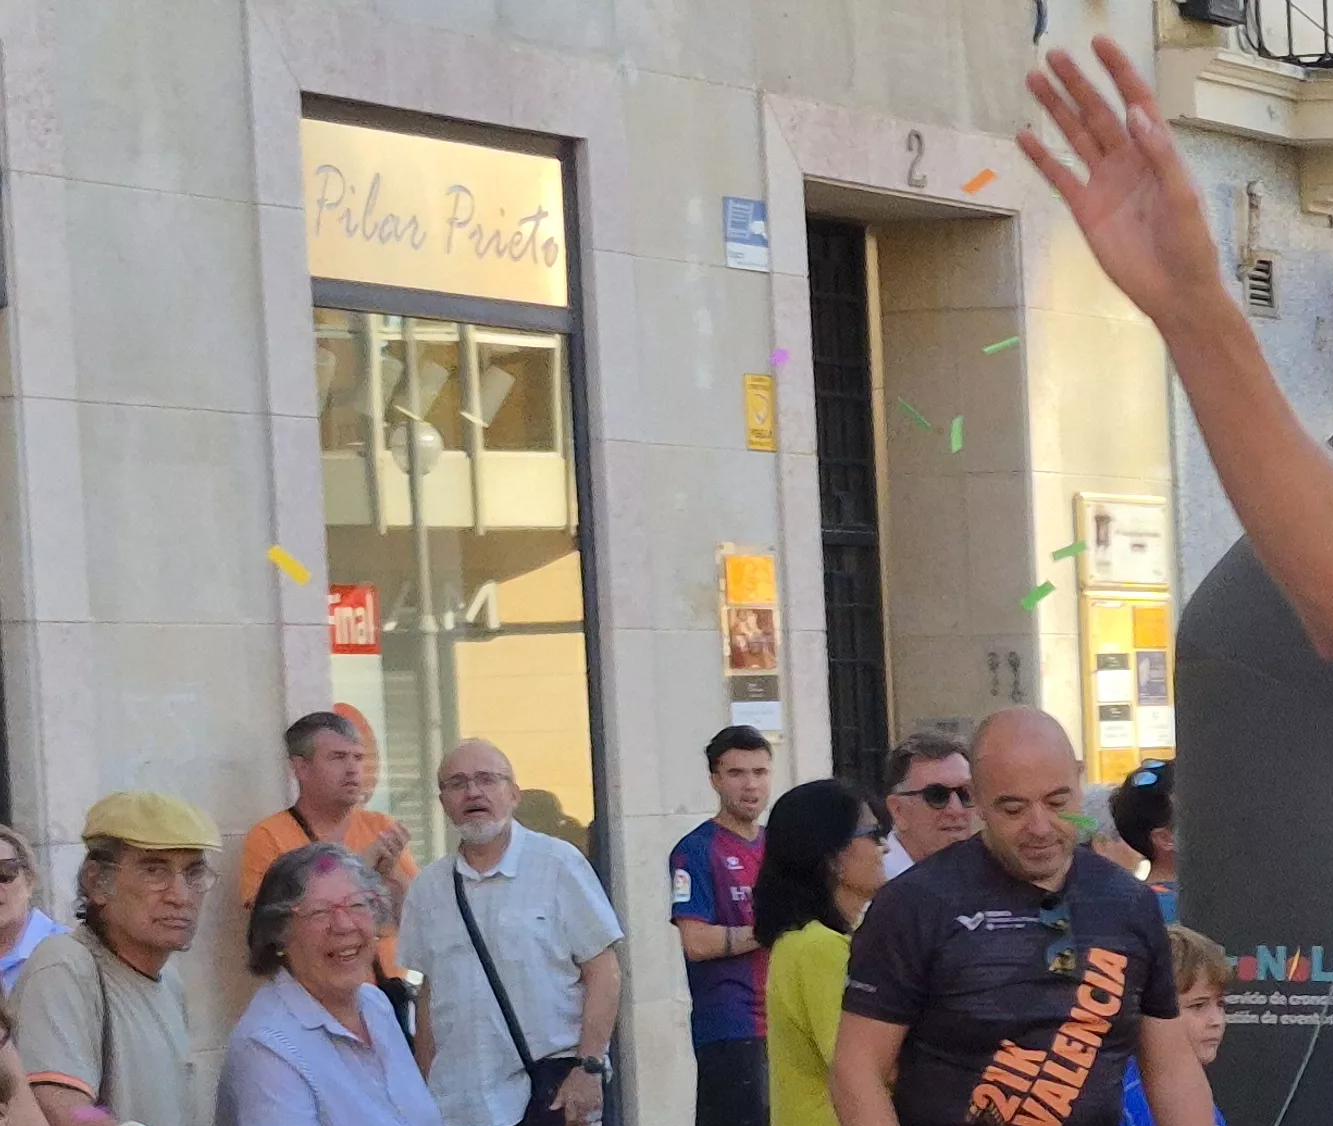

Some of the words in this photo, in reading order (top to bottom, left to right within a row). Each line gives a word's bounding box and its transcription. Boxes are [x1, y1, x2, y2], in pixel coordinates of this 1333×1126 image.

[906, 129, 927, 188] 2
[315, 164, 427, 250] Pilar
[446, 184, 559, 268] Prieto
